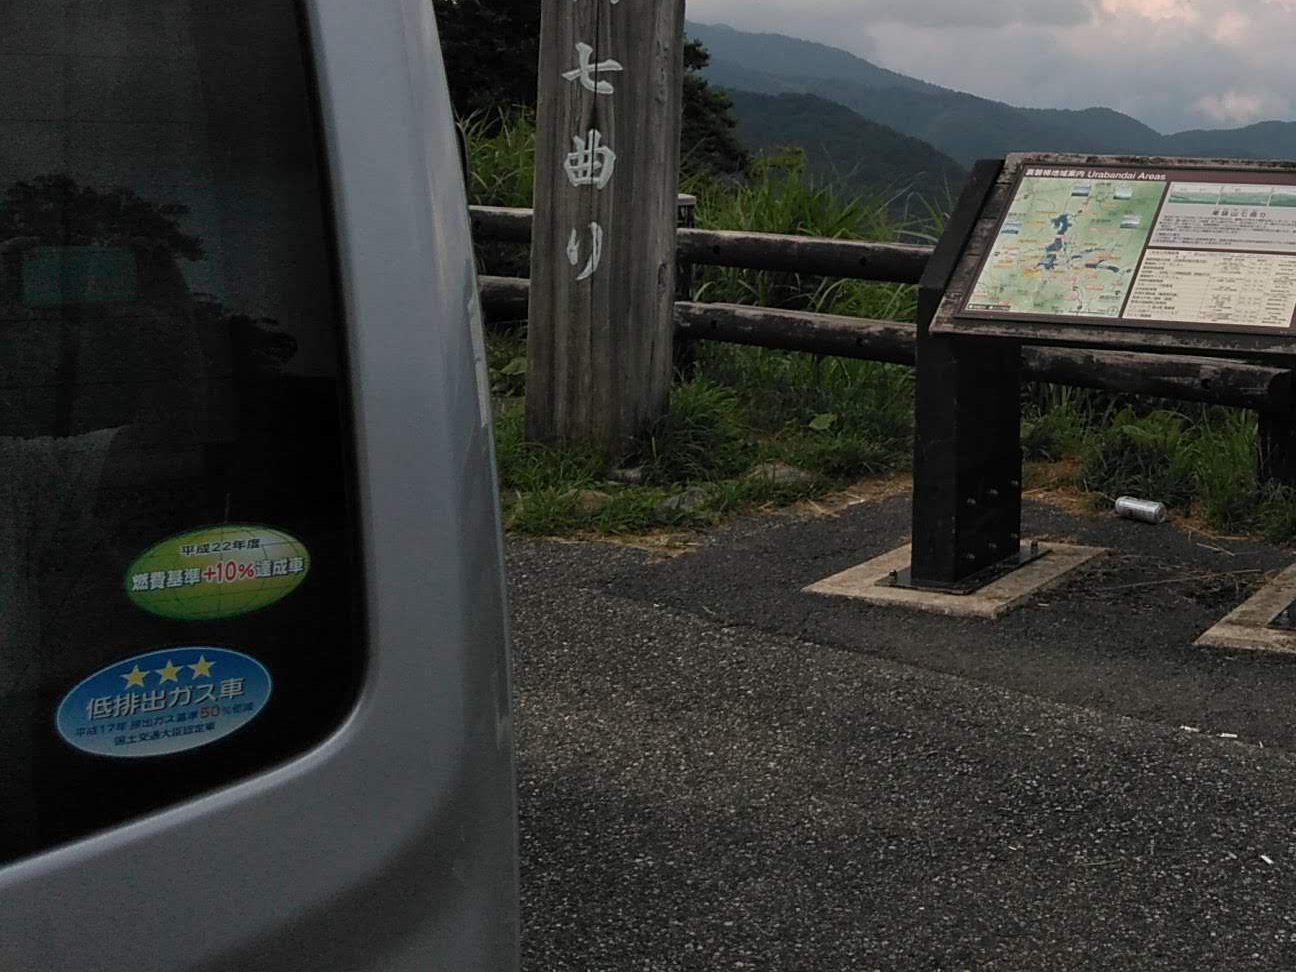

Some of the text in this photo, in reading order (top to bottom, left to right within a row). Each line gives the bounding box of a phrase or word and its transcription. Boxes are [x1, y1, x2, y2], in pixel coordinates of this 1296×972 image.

[1087, 170, 1136, 179] Urabandai
[1137, 171, 1166, 181] Areas
[180, 538, 261, 556] 平成22年度
[132, 558, 305, 591] 燃費基準+10%達成車
[86, 677, 246, 720] 低排出ガス車
